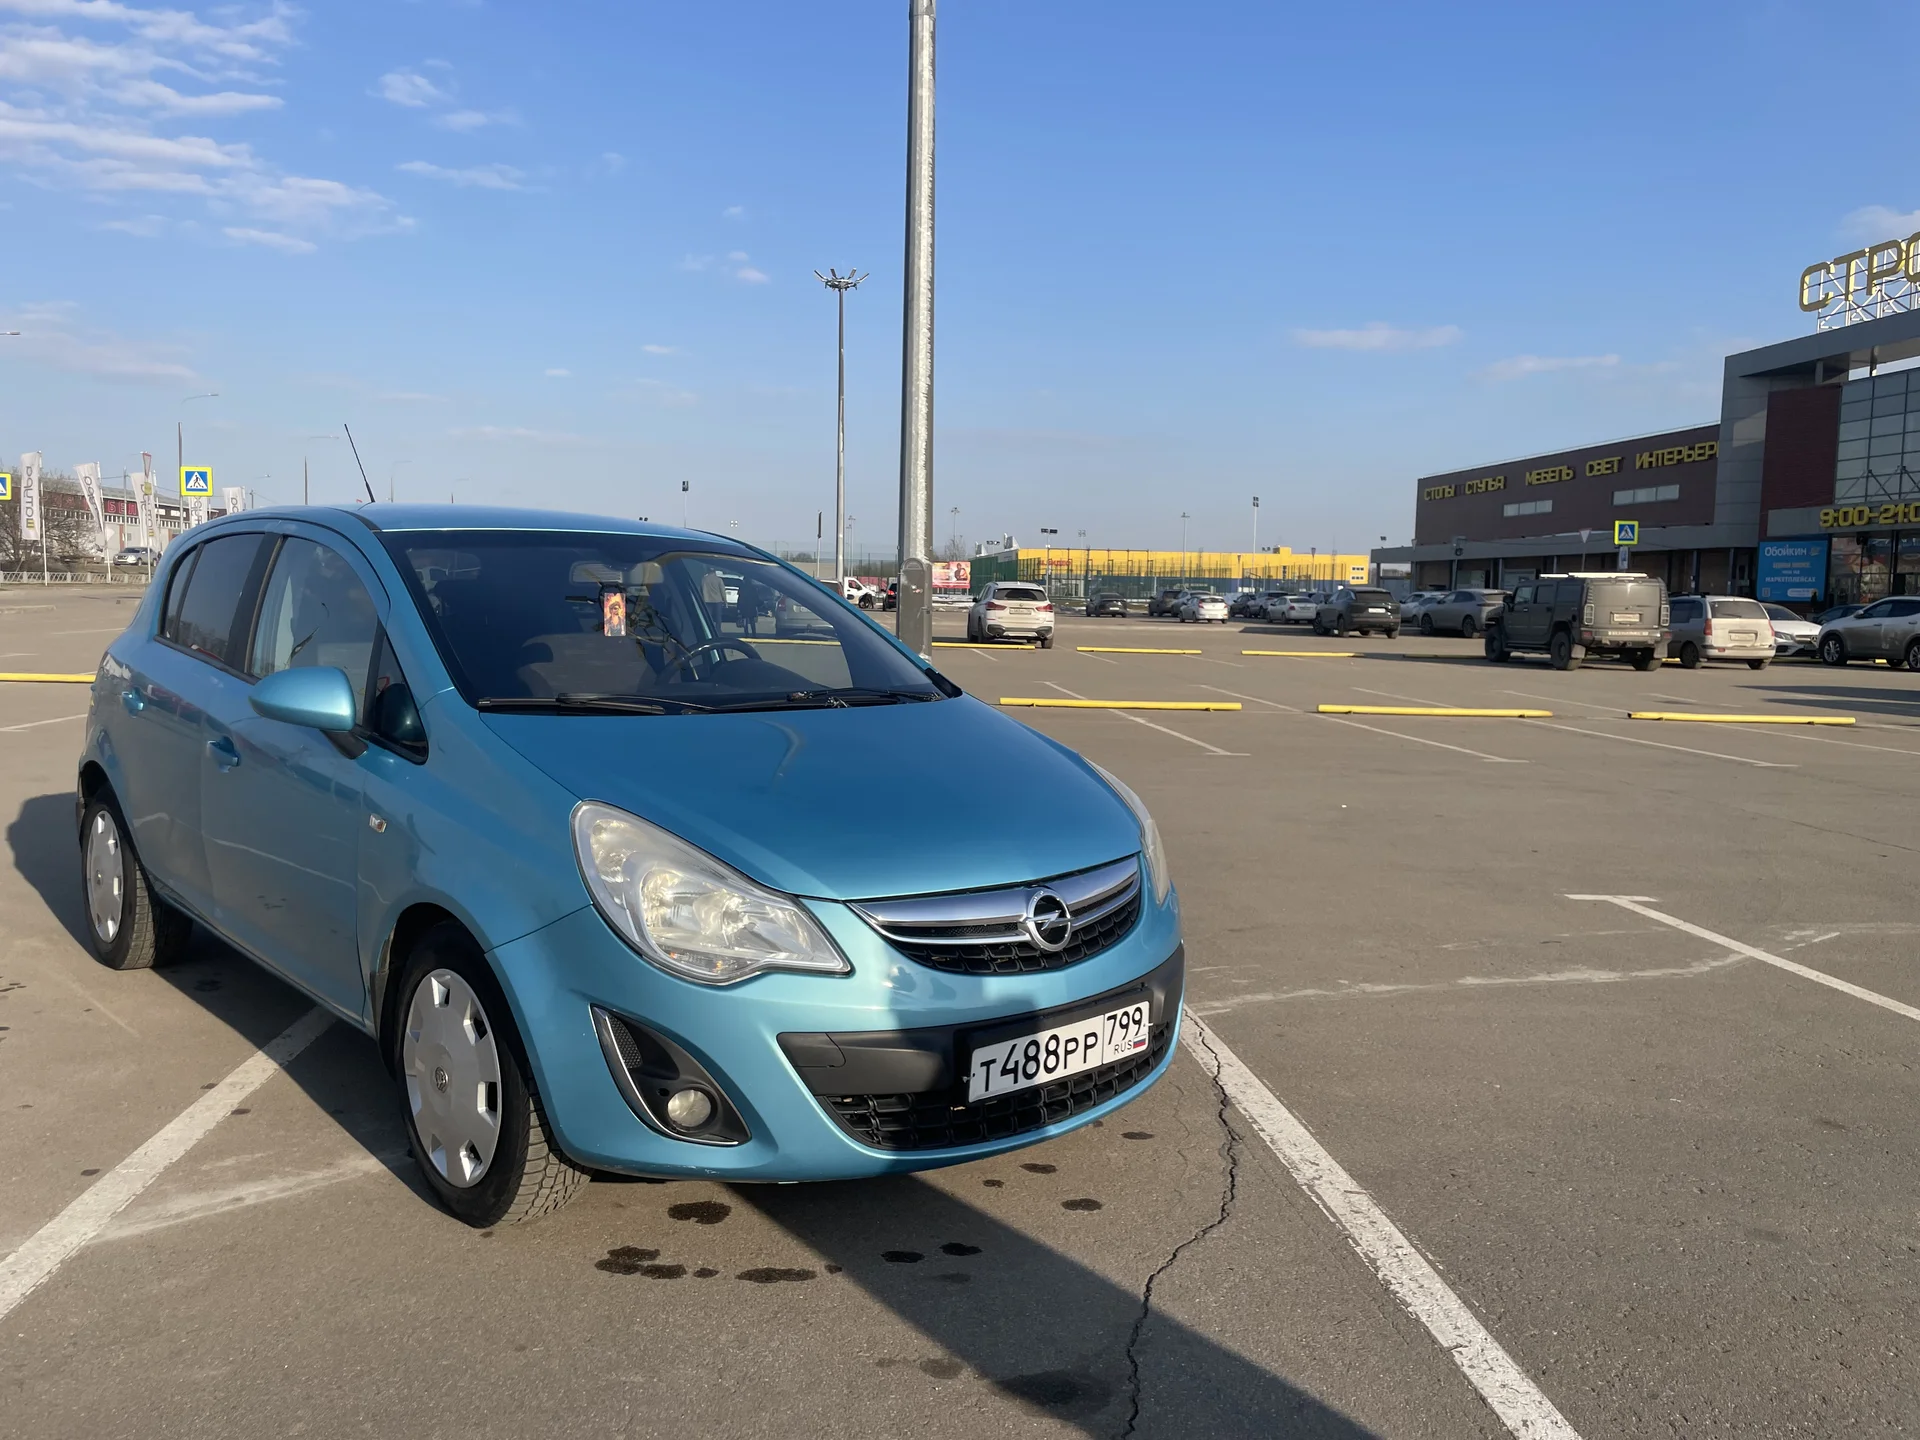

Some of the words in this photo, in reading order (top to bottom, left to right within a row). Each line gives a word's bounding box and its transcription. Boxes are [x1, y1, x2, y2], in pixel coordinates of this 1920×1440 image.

[1424, 484, 1455, 501] СТОЛЫ
[1465, 476, 1505, 495] СТУЛЬЯ
[1525, 465, 1574, 486] МЕБЕЛЬ
[1585, 456, 1622, 477] СВЕТ
[1635, 440, 1720, 470] ИНТЕРЬЕР
[1764, 545, 1807, 556] Обойкин
[980, 1032, 1099, 1093] Т488РР
[1106, 1006, 1143, 1046] 799
[1114, 1041, 1133, 1055] RUS
